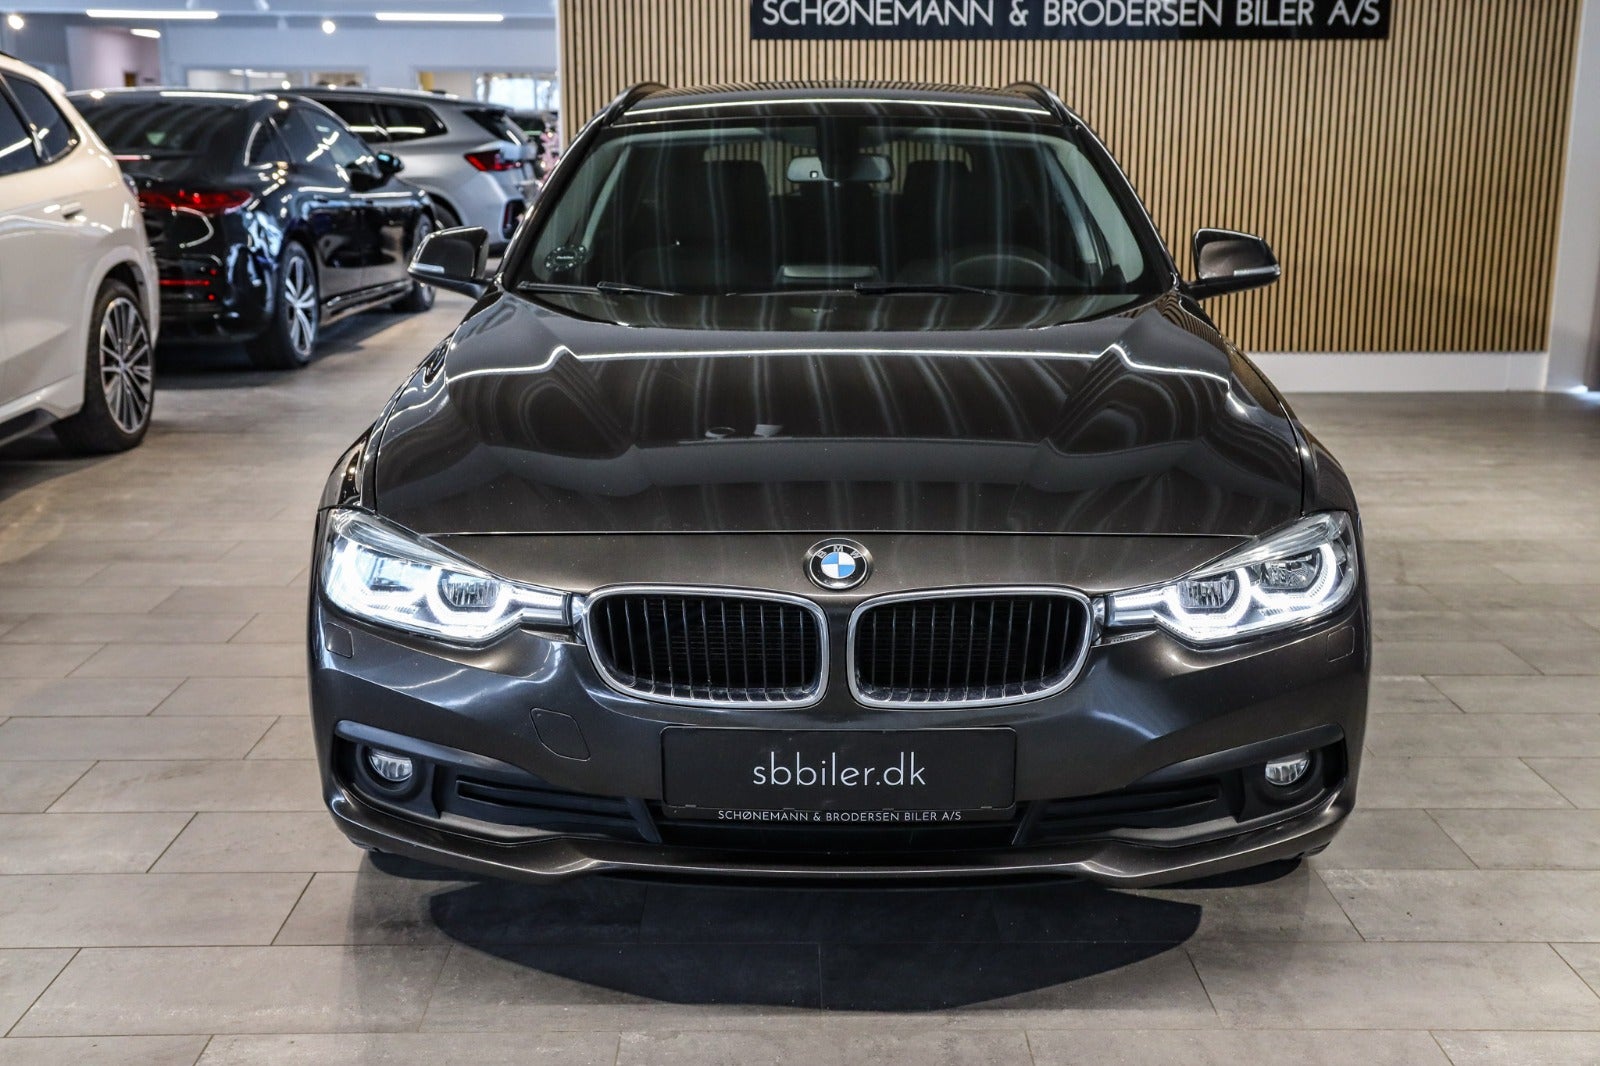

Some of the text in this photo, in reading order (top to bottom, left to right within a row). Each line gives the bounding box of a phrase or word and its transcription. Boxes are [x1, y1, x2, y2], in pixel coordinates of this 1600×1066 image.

[762, 0, 1380, 27] SCHØNEMANN & BRODERSEN BILER A/S
[815, 544, 861, 559] BMW
[752, 751, 926, 787] sbbiler.dk
[718, 810, 962, 822] SCHØNEMANN & BRODERSEN BILER A/S
